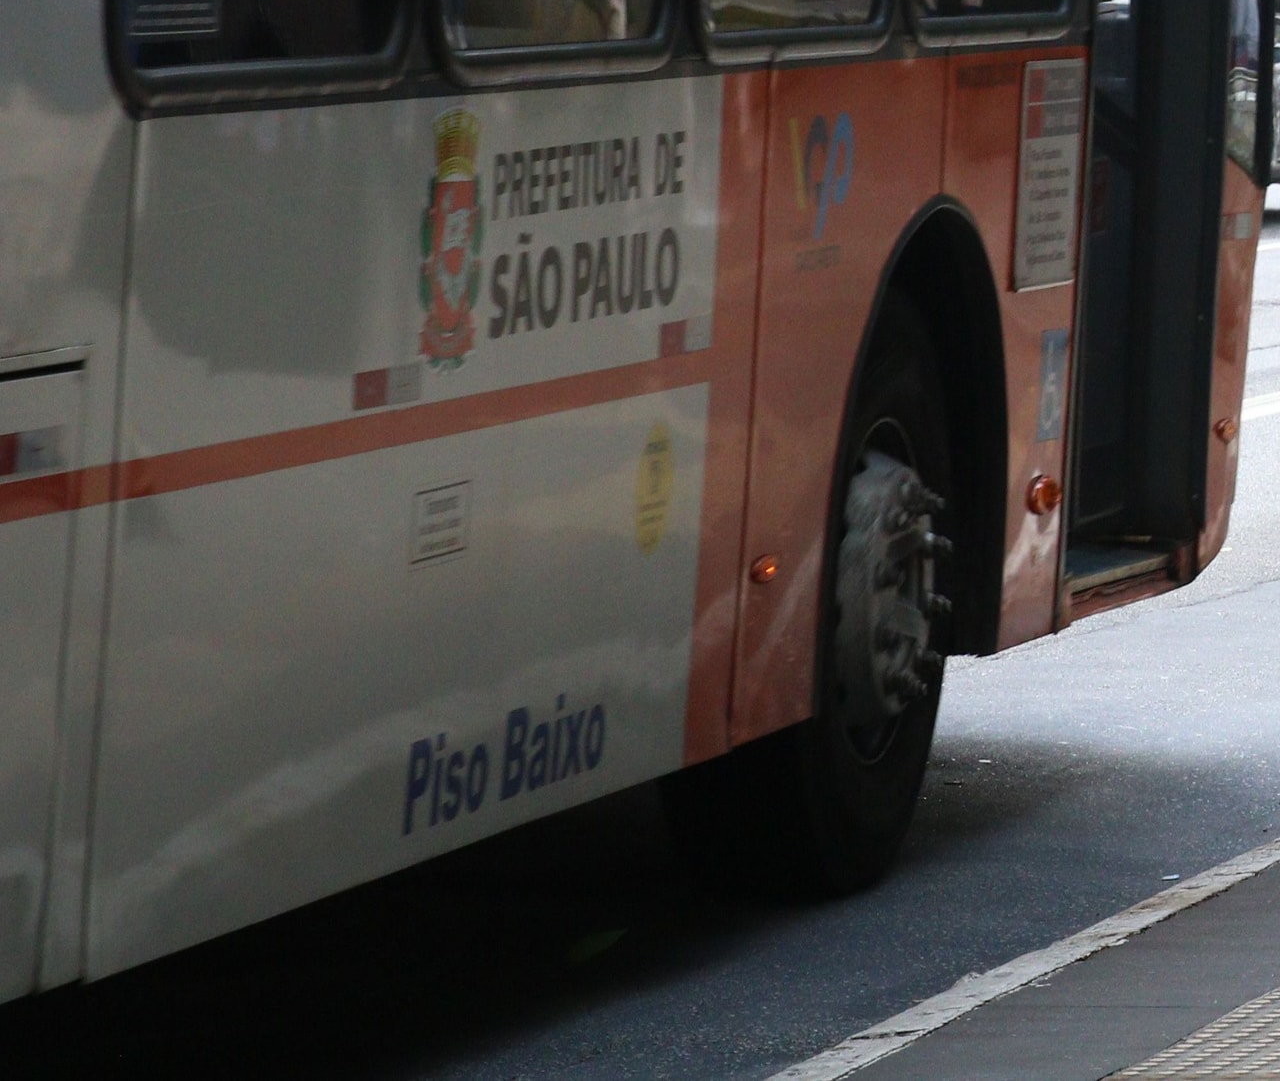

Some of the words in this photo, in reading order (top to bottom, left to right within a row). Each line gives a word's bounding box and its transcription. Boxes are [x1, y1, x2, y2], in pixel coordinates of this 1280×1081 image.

[491, 135, 641, 221] PREFEITURA
[653, 130, 686, 198] DE
[488, 231, 563, 340] SÃO
[570, 226, 680, 323] PAULO
[402, 732, 489, 836] Piso
[499, 693, 604, 802] Baixo
